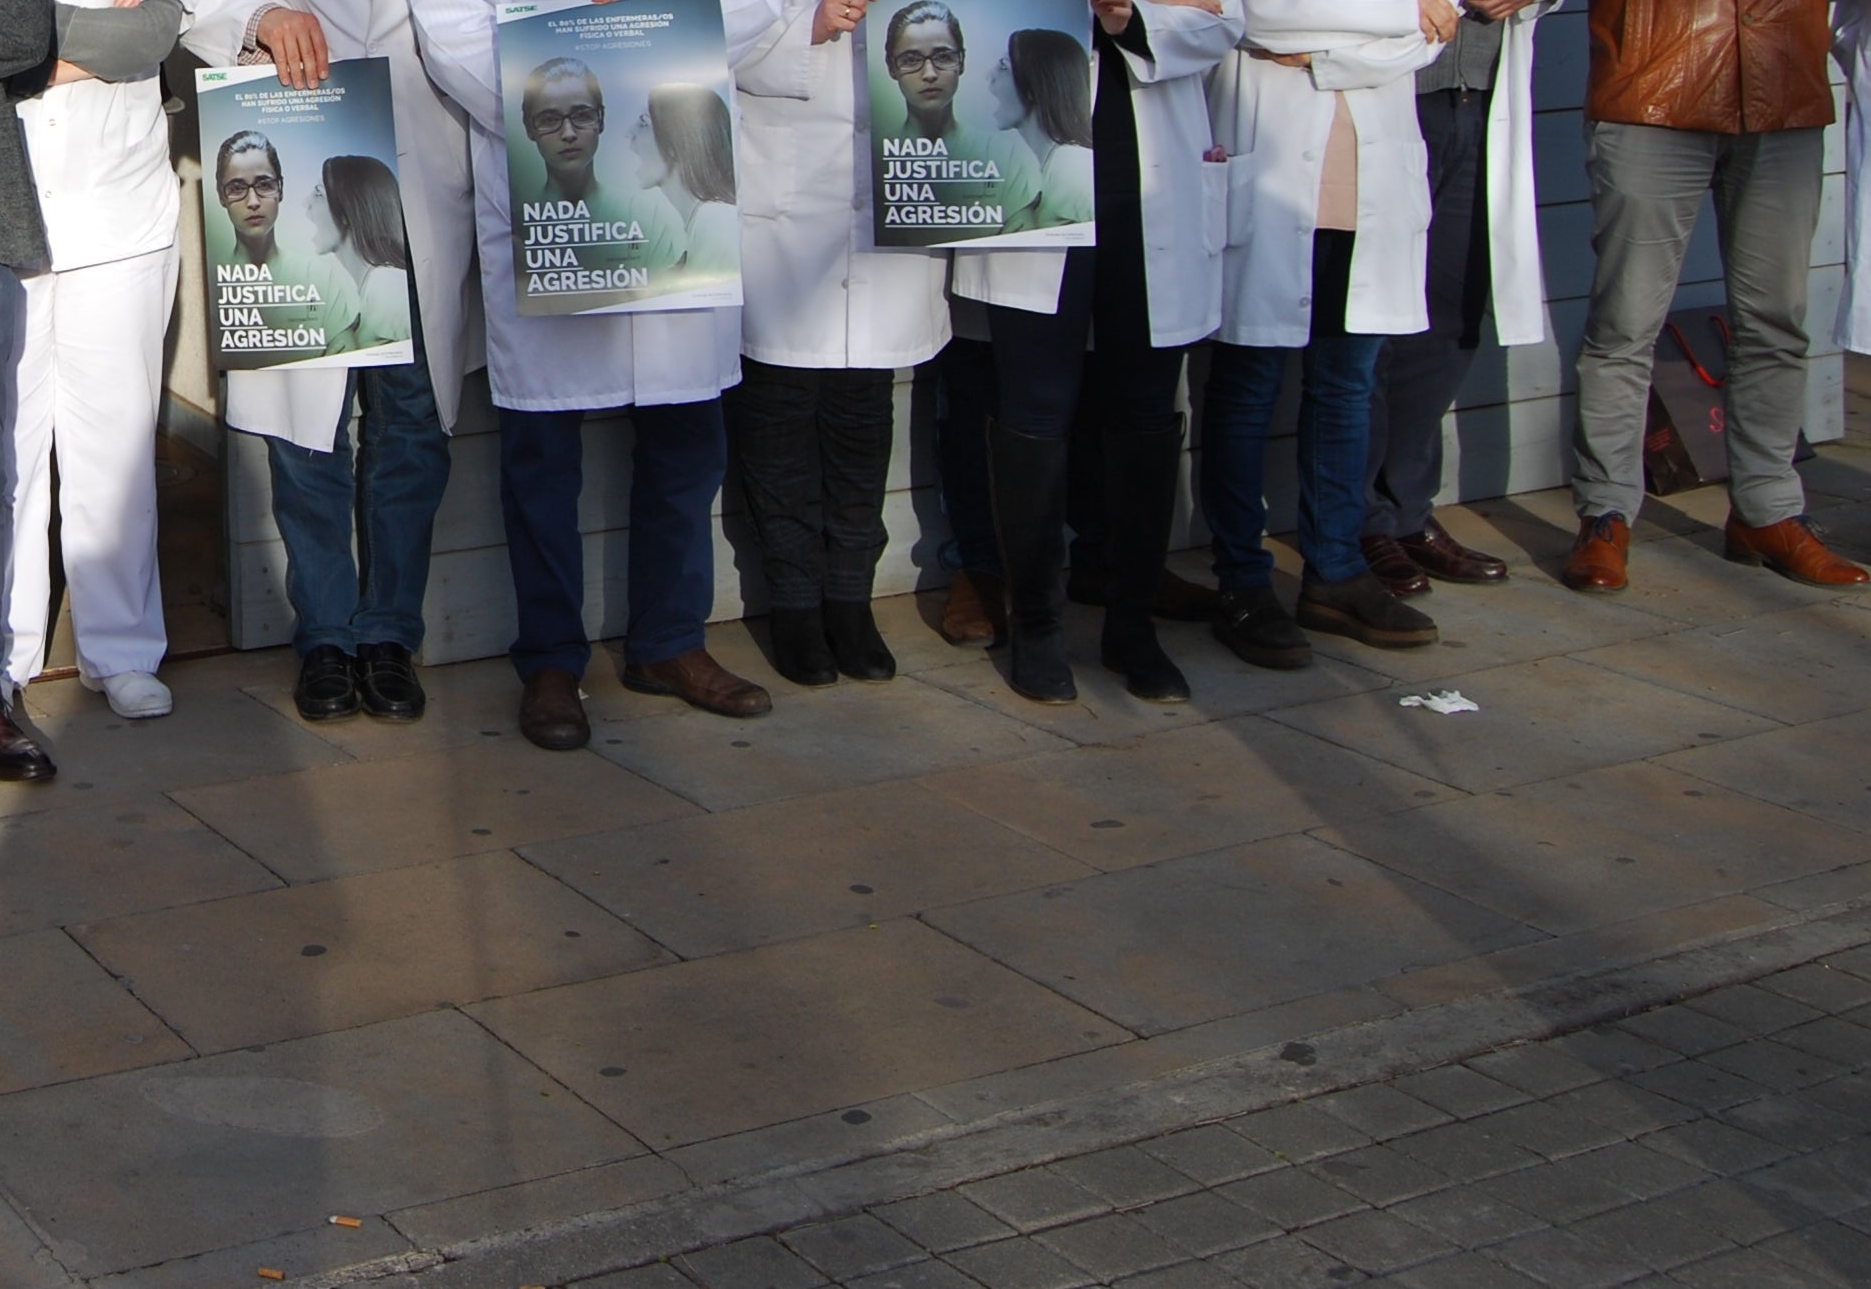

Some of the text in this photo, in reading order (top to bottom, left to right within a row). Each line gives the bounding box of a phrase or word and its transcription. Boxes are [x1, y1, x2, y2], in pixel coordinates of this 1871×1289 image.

[505, 4, 538, 14] SATSE
[883, 138, 948, 156] NADA
[884, 159, 999, 178] JUSTIFICA
[884, 183, 935, 201] UNA
[523, 199, 590, 221] NADA
[885, 200, 1002, 224] AGRESIÓN
[525, 220, 644, 245] JUSTIFICA
[525, 247, 578, 268] UNA
[216, 263, 273, 282] NADA
[527, 263, 648, 292] AGRESIÓN
[218, 284, 320, 304] JUSTIFICA
[218, 307, 263, 325] UNA
[220, 324, 325, 347] AGRESIÓN
